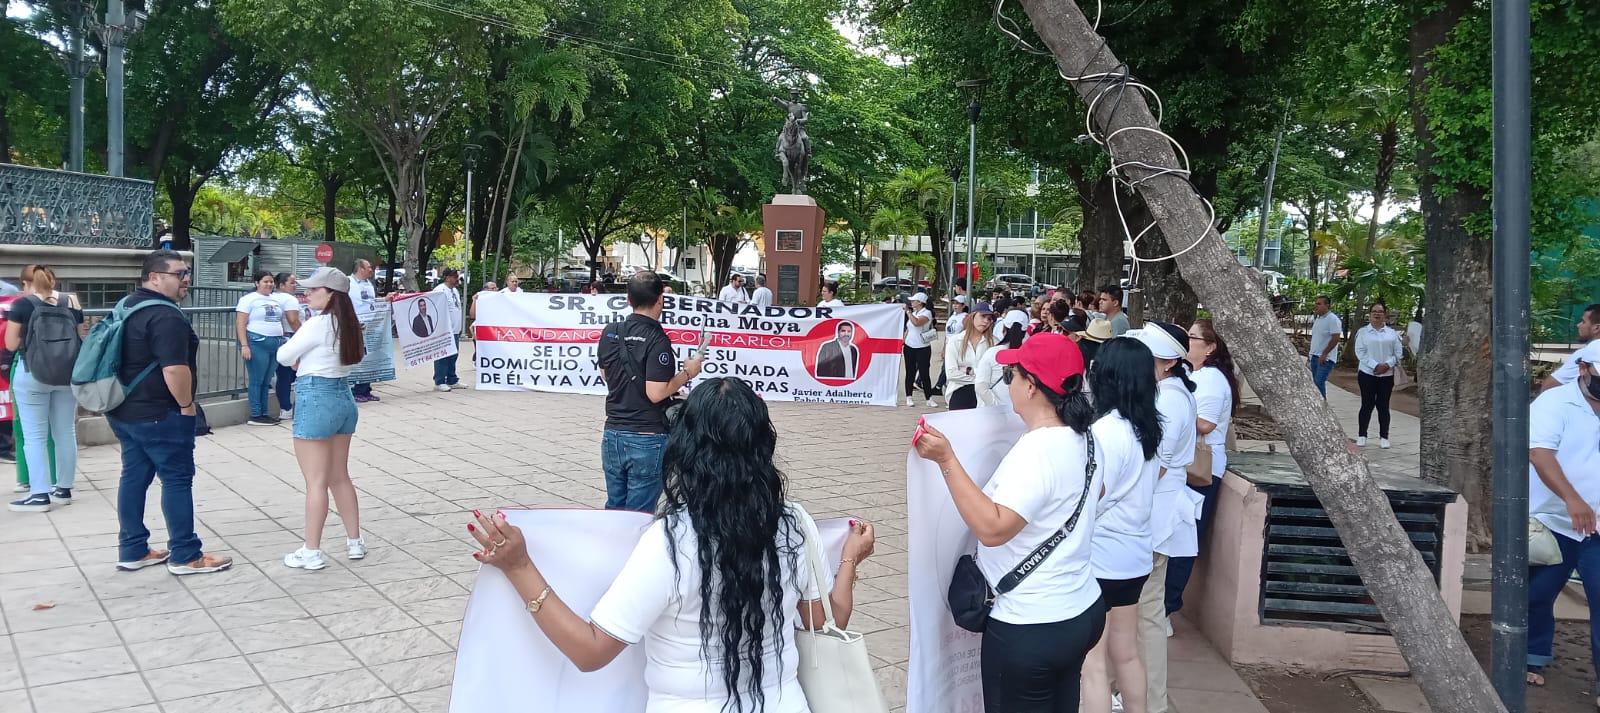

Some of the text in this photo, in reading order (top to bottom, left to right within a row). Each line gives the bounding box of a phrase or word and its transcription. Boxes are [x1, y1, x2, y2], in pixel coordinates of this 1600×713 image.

[549, 295, 833, 319] SR. GBERNADOR
[661, 311, 730, 328] Rocha
[738, 316, 801, 335] Moya
[496, 329, 602, 341] ¡AYUDANO
[533, 346, 552, 357] SE
[559, 346, 581, 357] LO
[716, 349, 737, 361] SU
[481, 357, 583, 372] DOMICILIO,
[735, 364, 789, 378] NADA
[481, 371, 606, 387] DE ÉL Y YA VA
[743, 380, 789, 393] ORAS
[792, 389, 873, 399] Javier Adalberto
